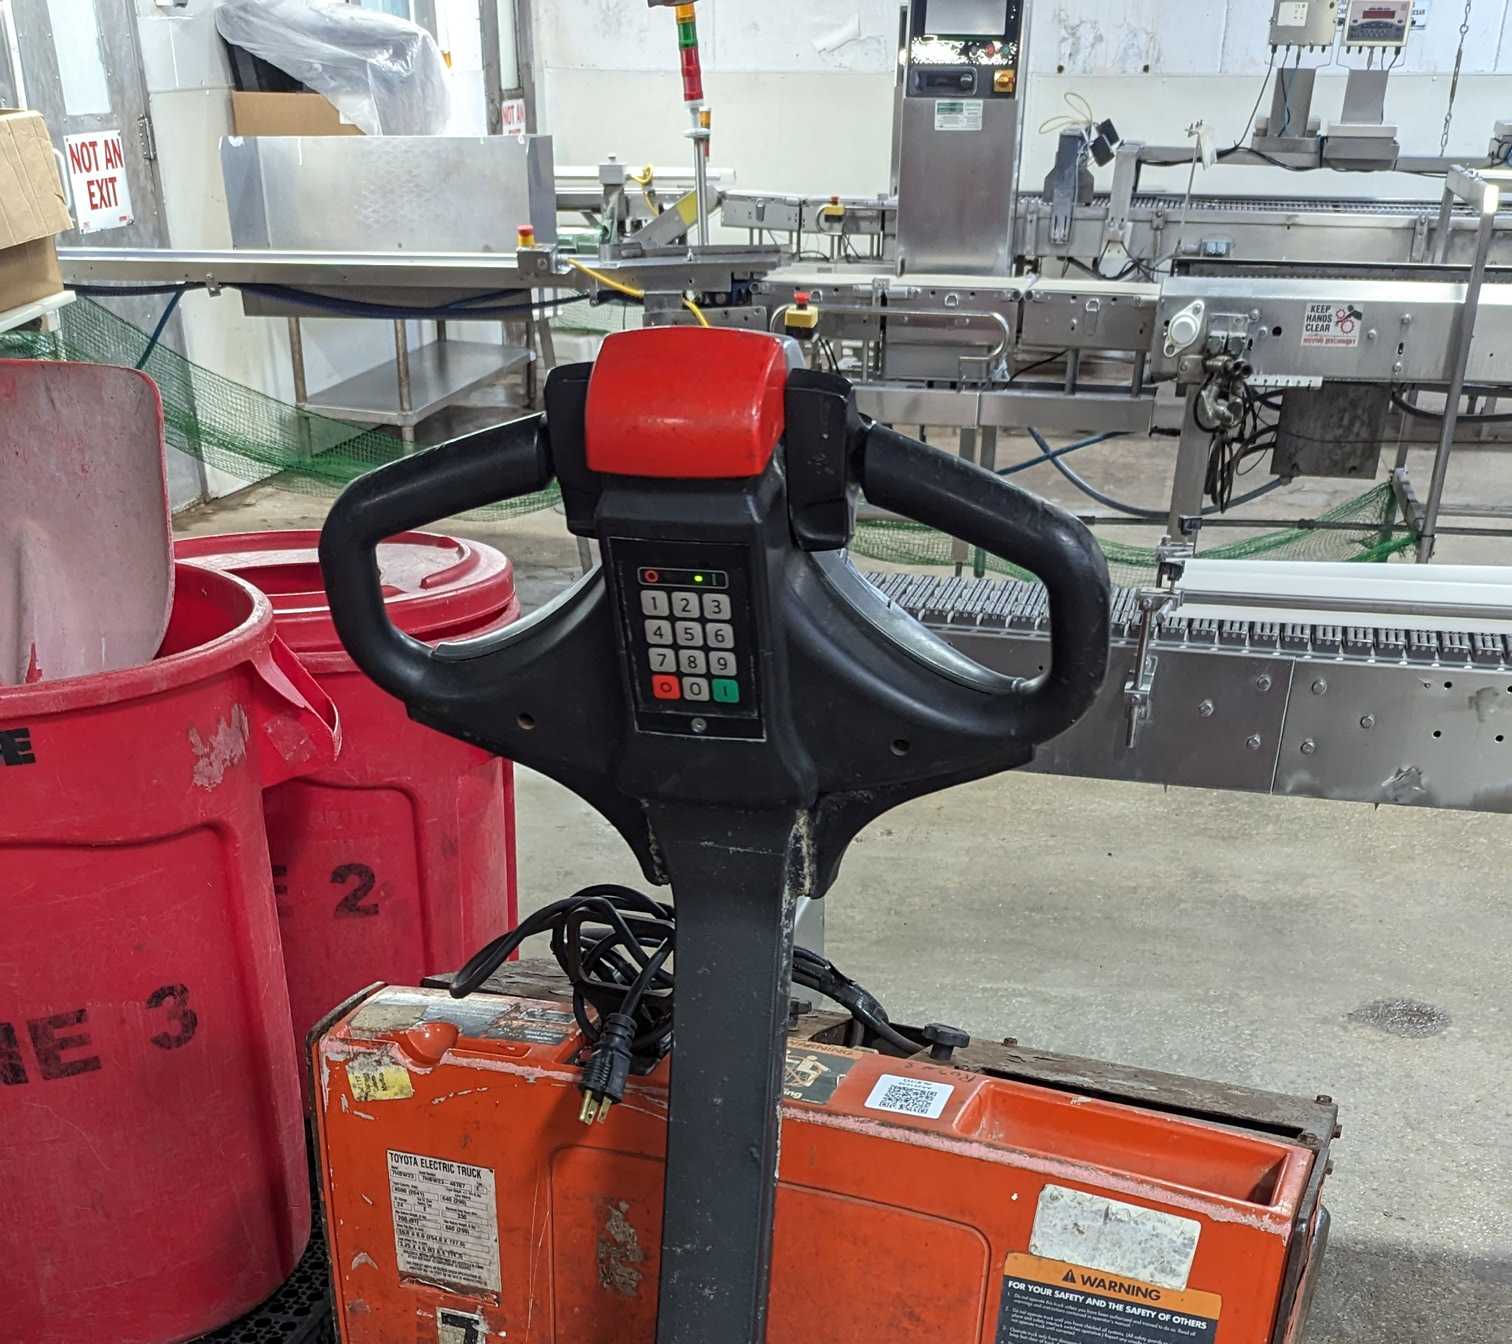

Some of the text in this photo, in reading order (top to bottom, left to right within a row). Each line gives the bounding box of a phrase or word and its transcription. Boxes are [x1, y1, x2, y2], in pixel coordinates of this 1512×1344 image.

[69, 138, 123, 174] NOT AN
[87, 177, 118, 210] EXIT
[1306, 314, 1333, 322] HANDS
[1310, 304, 1331, 313] KEEP
[1305, 323, 1330, 332] CLEAR
[651, 597, 722, 614] 1 2 3
[653, 626, 725, 643] 4 5 6
[657, 654, 727, 670] 7 8 9
[331, 864, 379, 917] 2
[147, 984, 198, 1050] 3
[388, 1152, 418, 1166] TOYOTA
[420, 1158, 454, 1173] ELECTRIC
[457, 1165, 481, 1179] TRUCK
[1080, 1274, 1161, 1301] WARNING
[1008, 1280, 1207, 1329] FOR YOUR SAFETY AND THE SAFETY OF OTHERS
